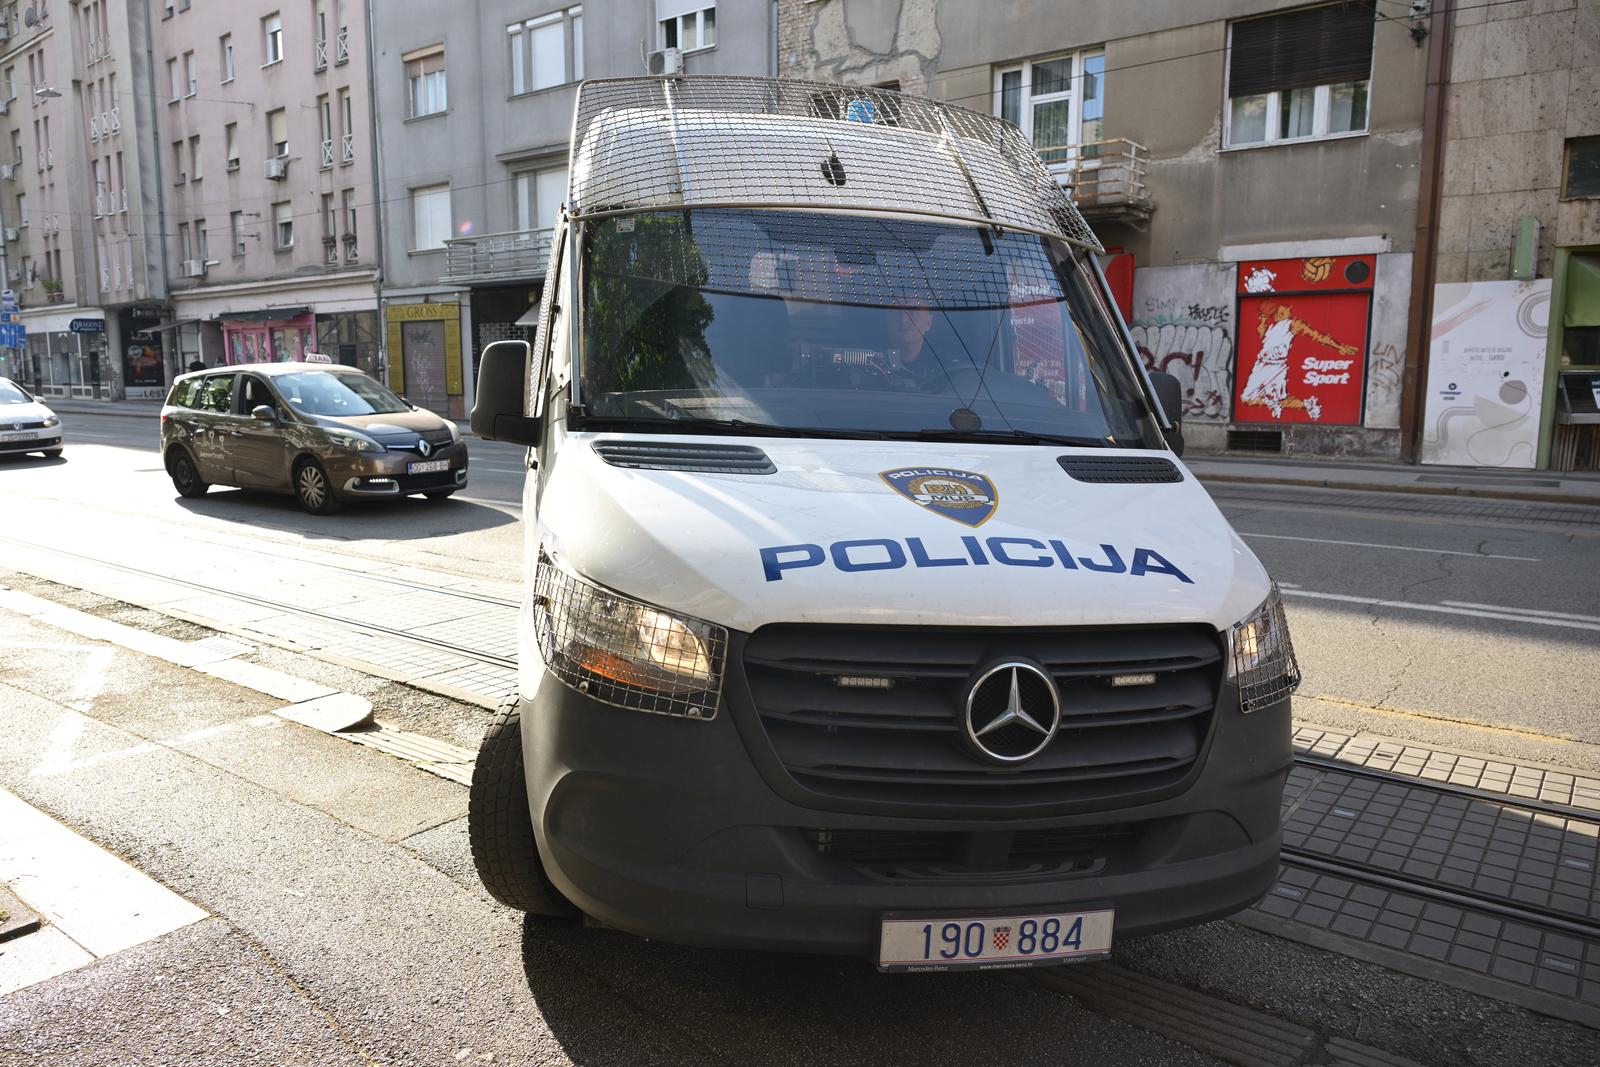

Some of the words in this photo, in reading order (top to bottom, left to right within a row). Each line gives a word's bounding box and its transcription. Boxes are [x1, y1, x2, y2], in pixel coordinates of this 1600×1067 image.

[1302, 357, 1354, 373] Super
[1303, 371, 1351, 387] Sport
[888, 469, 984, 482] POLICIJA
[760, 536, 1196, 584] POLICIJA
[922, 921, 986, 960] 190
[1017, 916, 1083, 955] 884
